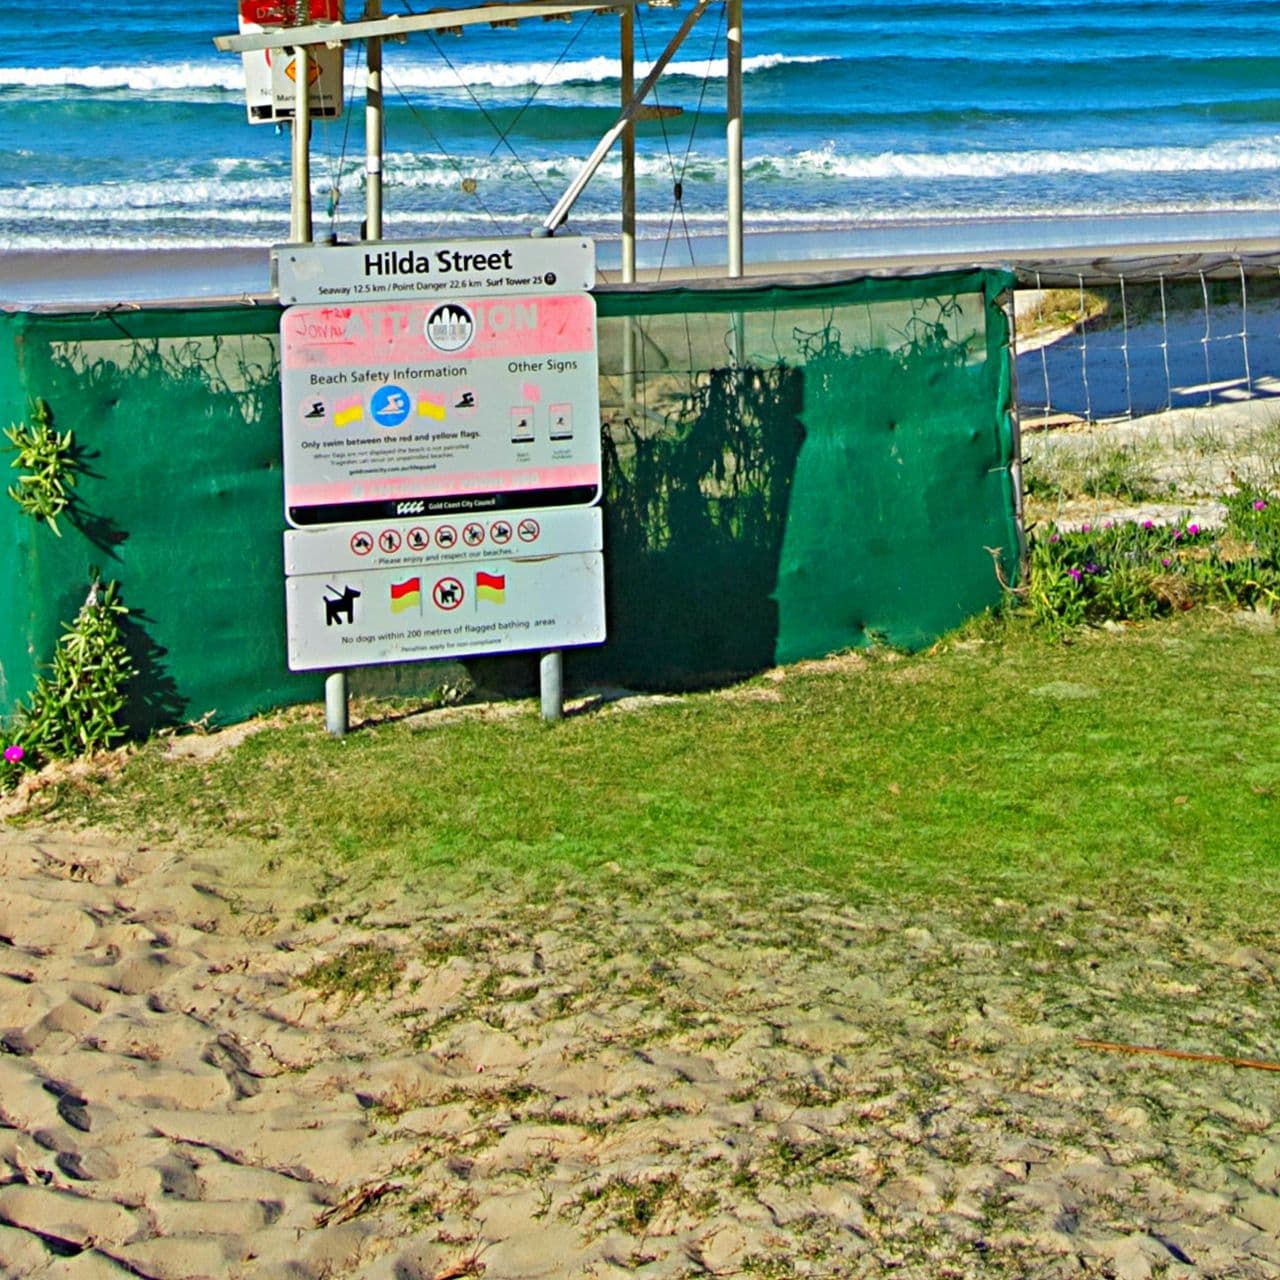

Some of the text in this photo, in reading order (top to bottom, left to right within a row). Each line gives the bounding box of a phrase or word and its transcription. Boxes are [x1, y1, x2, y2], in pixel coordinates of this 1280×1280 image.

[364, 248, 513, 276] Hilda Street
[318, 285, 351, 296] Seaway
[353, 284, 370, 293] 12.5
[372, 283, 386, 292] km
[392, 281, 415, 291] Point
[416, 280, 447, 291] Danger
[449, 280, 467, 289] 22.6
[469, 279, 482, 288] km
[486, 276, 543, 287] Surf Tower 25
[344, 303, 538, 338] ATTEION
[508, 359, 578, 374] Other Signs
[310, 366, 468, 385] Beach Safety Information
[301, 440, 320, 450] Only
[322, 440, 345, 448] swim
[346, 438, 382, 447] between
[383, 436, 397, 444] the
[414, 433, 430, 441] and
[431, 432, 458, 441] yellow
[428, 498, 496, 510] Gold Coast City Council
[378, 557, 402, 565] Please
[403, 555, 423, 565] enjoy
[425, 554, 439, 562] and
[441, 551, 467, 562] respect
[341, 618, 556, 645] No dogs within 200 metres of flagged bathing areas
